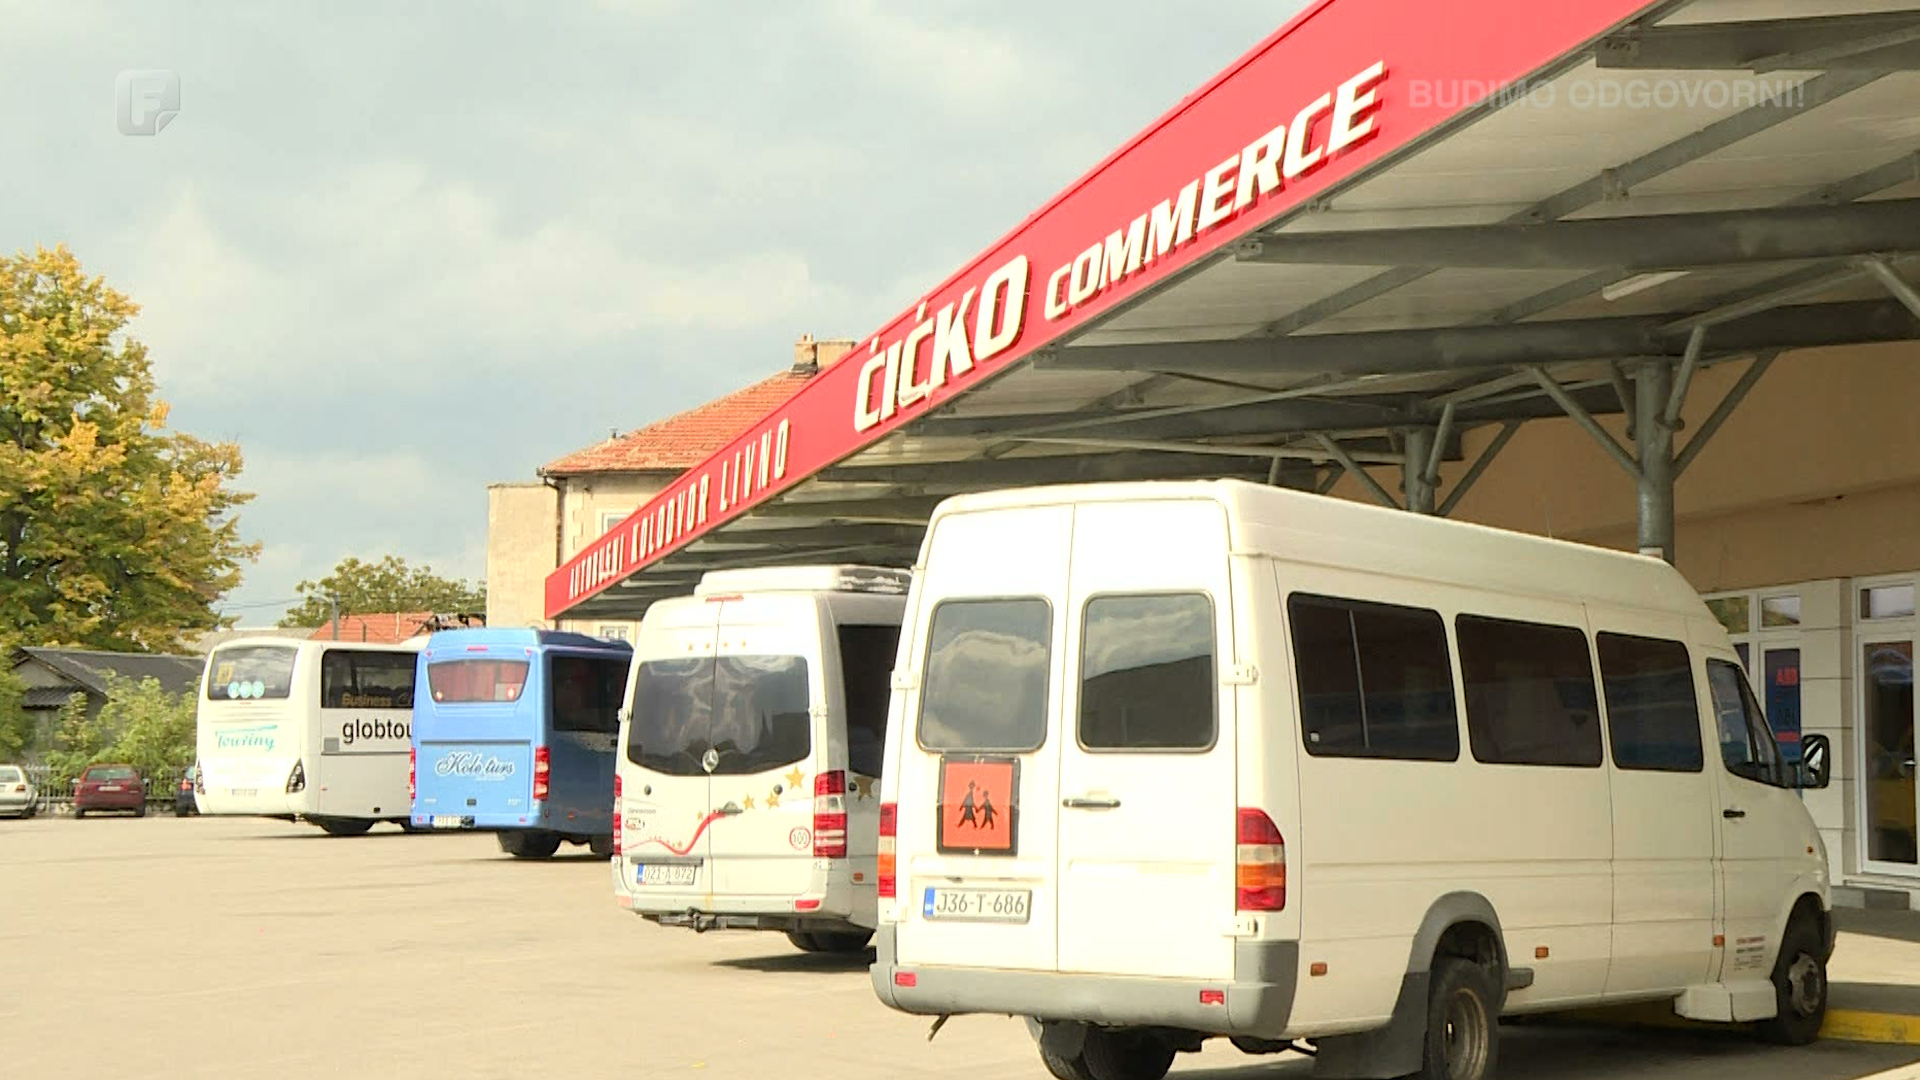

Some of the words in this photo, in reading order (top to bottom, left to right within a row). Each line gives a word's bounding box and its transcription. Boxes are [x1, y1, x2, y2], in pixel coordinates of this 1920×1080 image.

[1043, 59, 1384, 321] COMMERCE
[631, 473, 709, 565] KOLODVOR
[719, 418, 789, 512] LIVNO
[342, 691, 392, 707] Business
[215, 724, 276, 751] Touring
[936, 893, 1024, 915] J36-T-686
